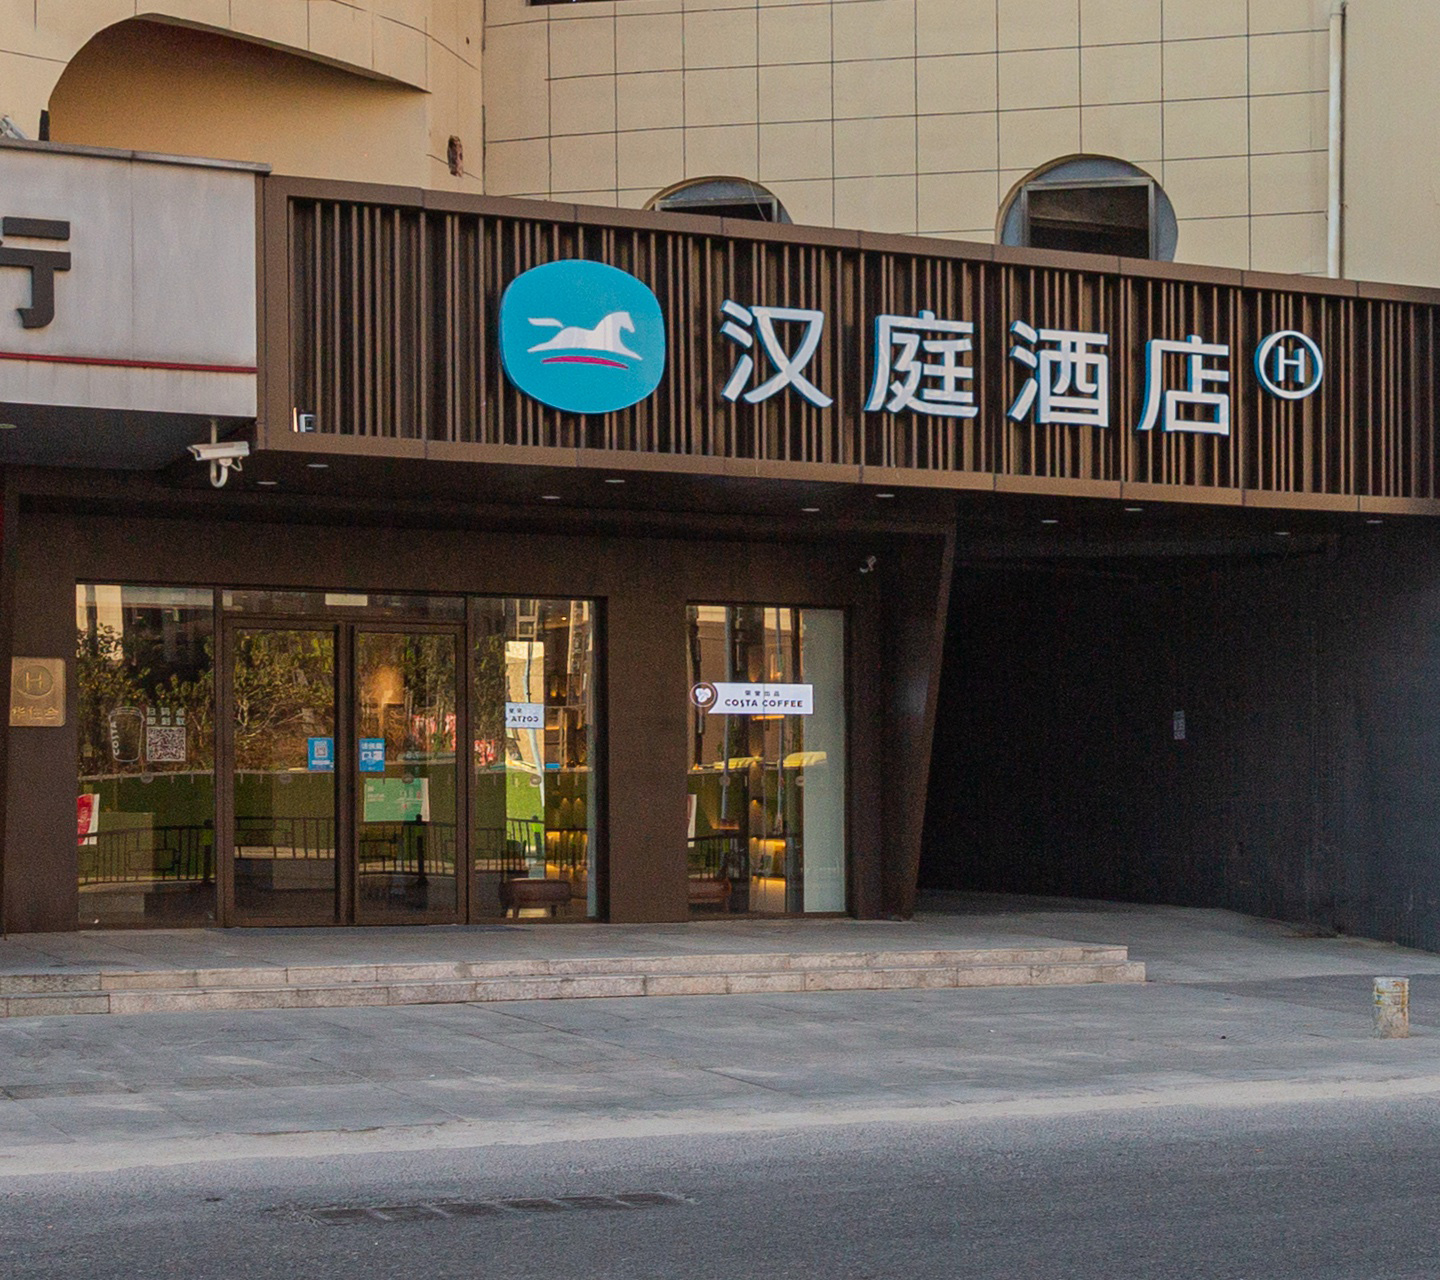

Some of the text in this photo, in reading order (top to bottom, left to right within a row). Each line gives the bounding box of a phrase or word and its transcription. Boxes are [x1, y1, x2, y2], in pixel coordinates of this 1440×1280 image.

[718, 298, 1233, 437] 汉庭酒店
[724, 699, 803, 708] COSTA COFFEE
